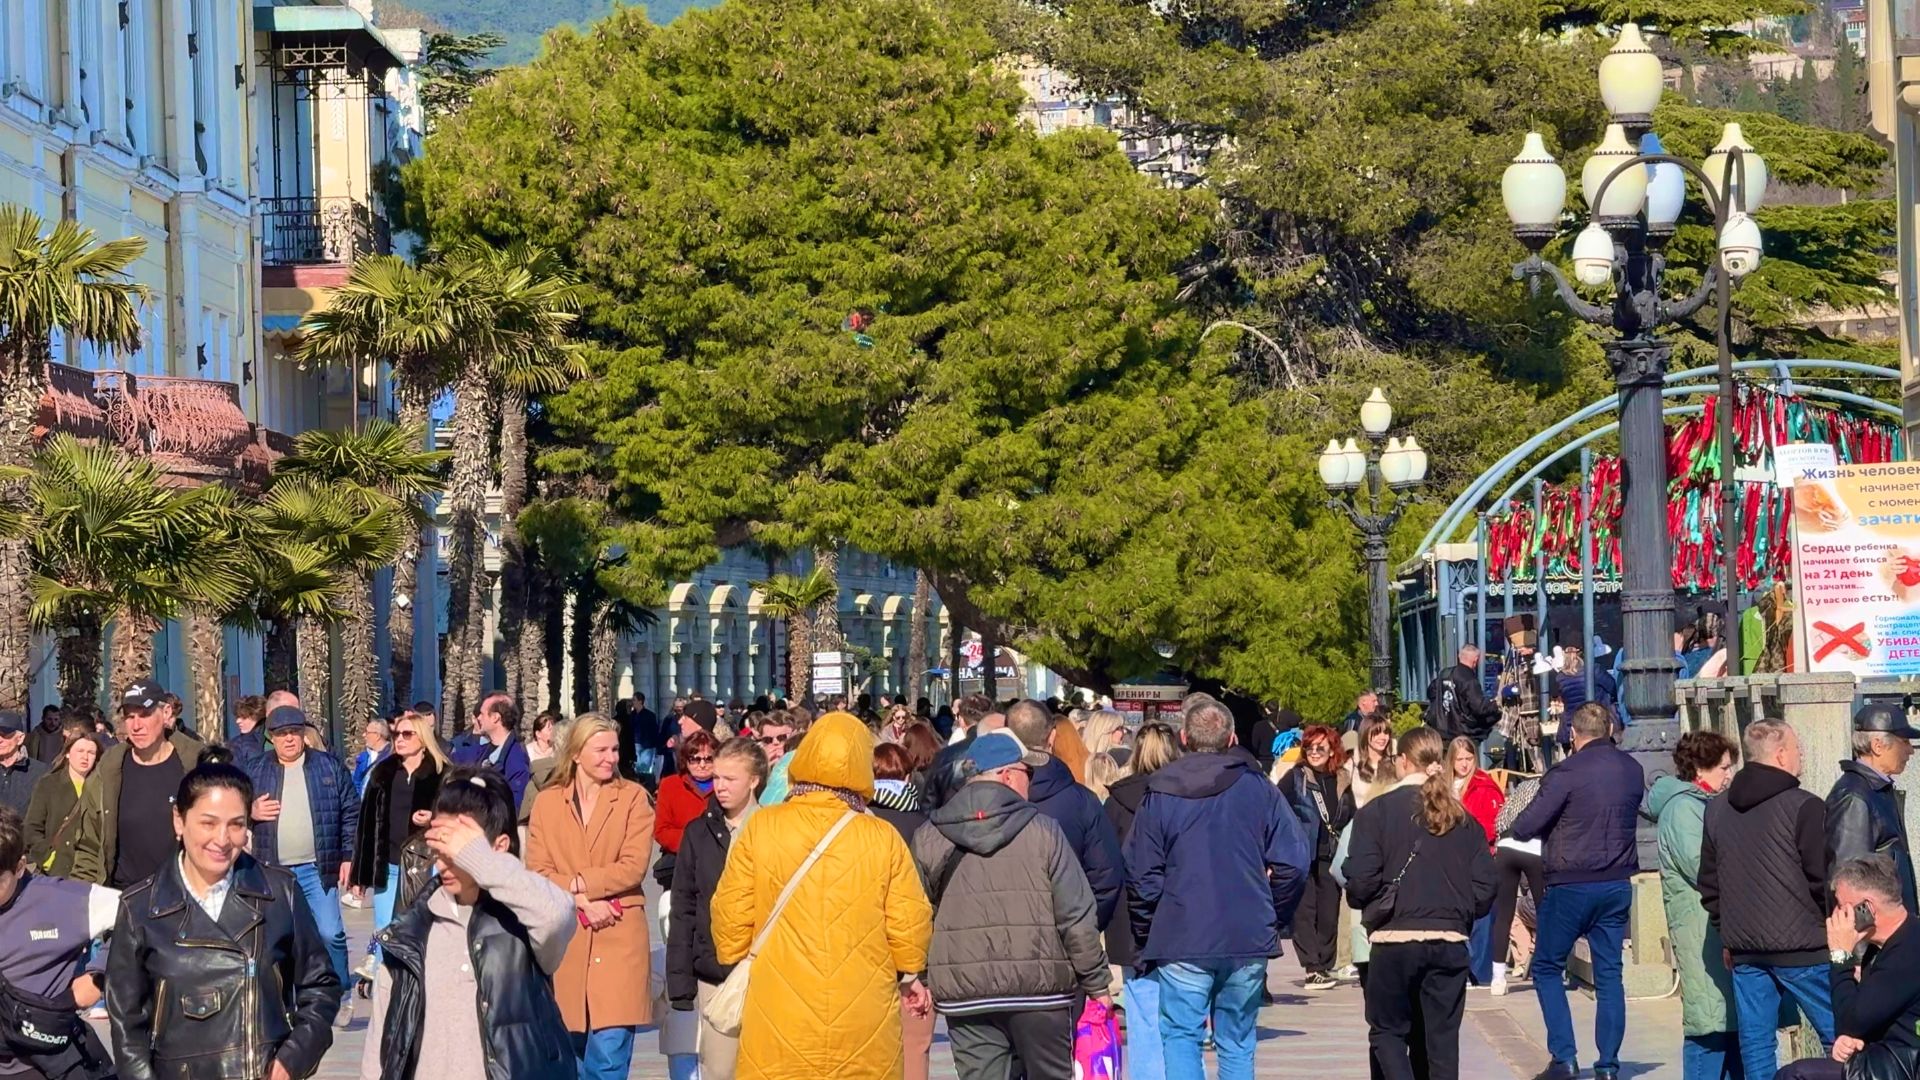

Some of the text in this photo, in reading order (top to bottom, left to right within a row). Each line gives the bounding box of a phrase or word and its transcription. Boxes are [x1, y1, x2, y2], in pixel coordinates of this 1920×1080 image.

[1802, 468, 1855, 479] Жизнь
[1860, 483, 1920, 493] начинает
[1802, 543, 1898, 554] Сердце ребенка
[1803, 556, 1888, 565] начинает биться
[1804, 570, 1873, 580] на 21 день
[1806, 597, 1814, 605] А
[1816, 598, 1821, 606] у
[1842, 596, 1860, 604] оно
[1877, 637, 1920, 646] УБИВА
